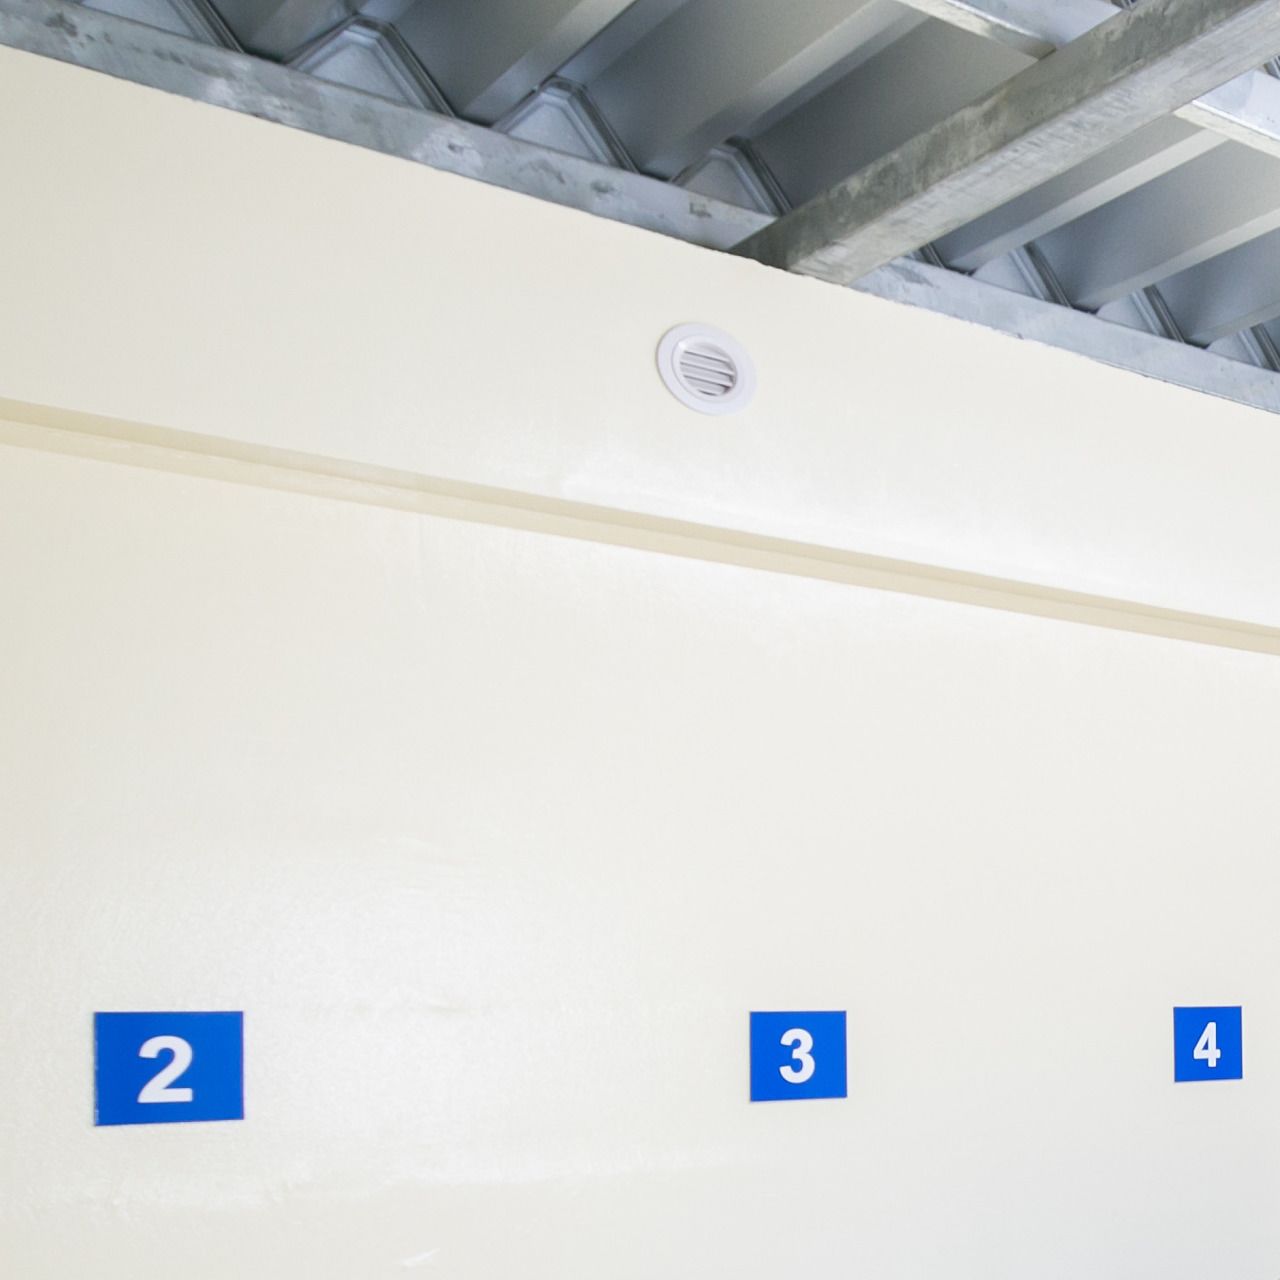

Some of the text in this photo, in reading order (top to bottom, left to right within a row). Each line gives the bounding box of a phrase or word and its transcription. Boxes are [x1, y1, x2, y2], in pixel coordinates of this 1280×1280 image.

[138, 1036, 192, 1103] 2
[779, 1029, 816, 1084] 3
[1193, 1021, 1221, 1068] 4
